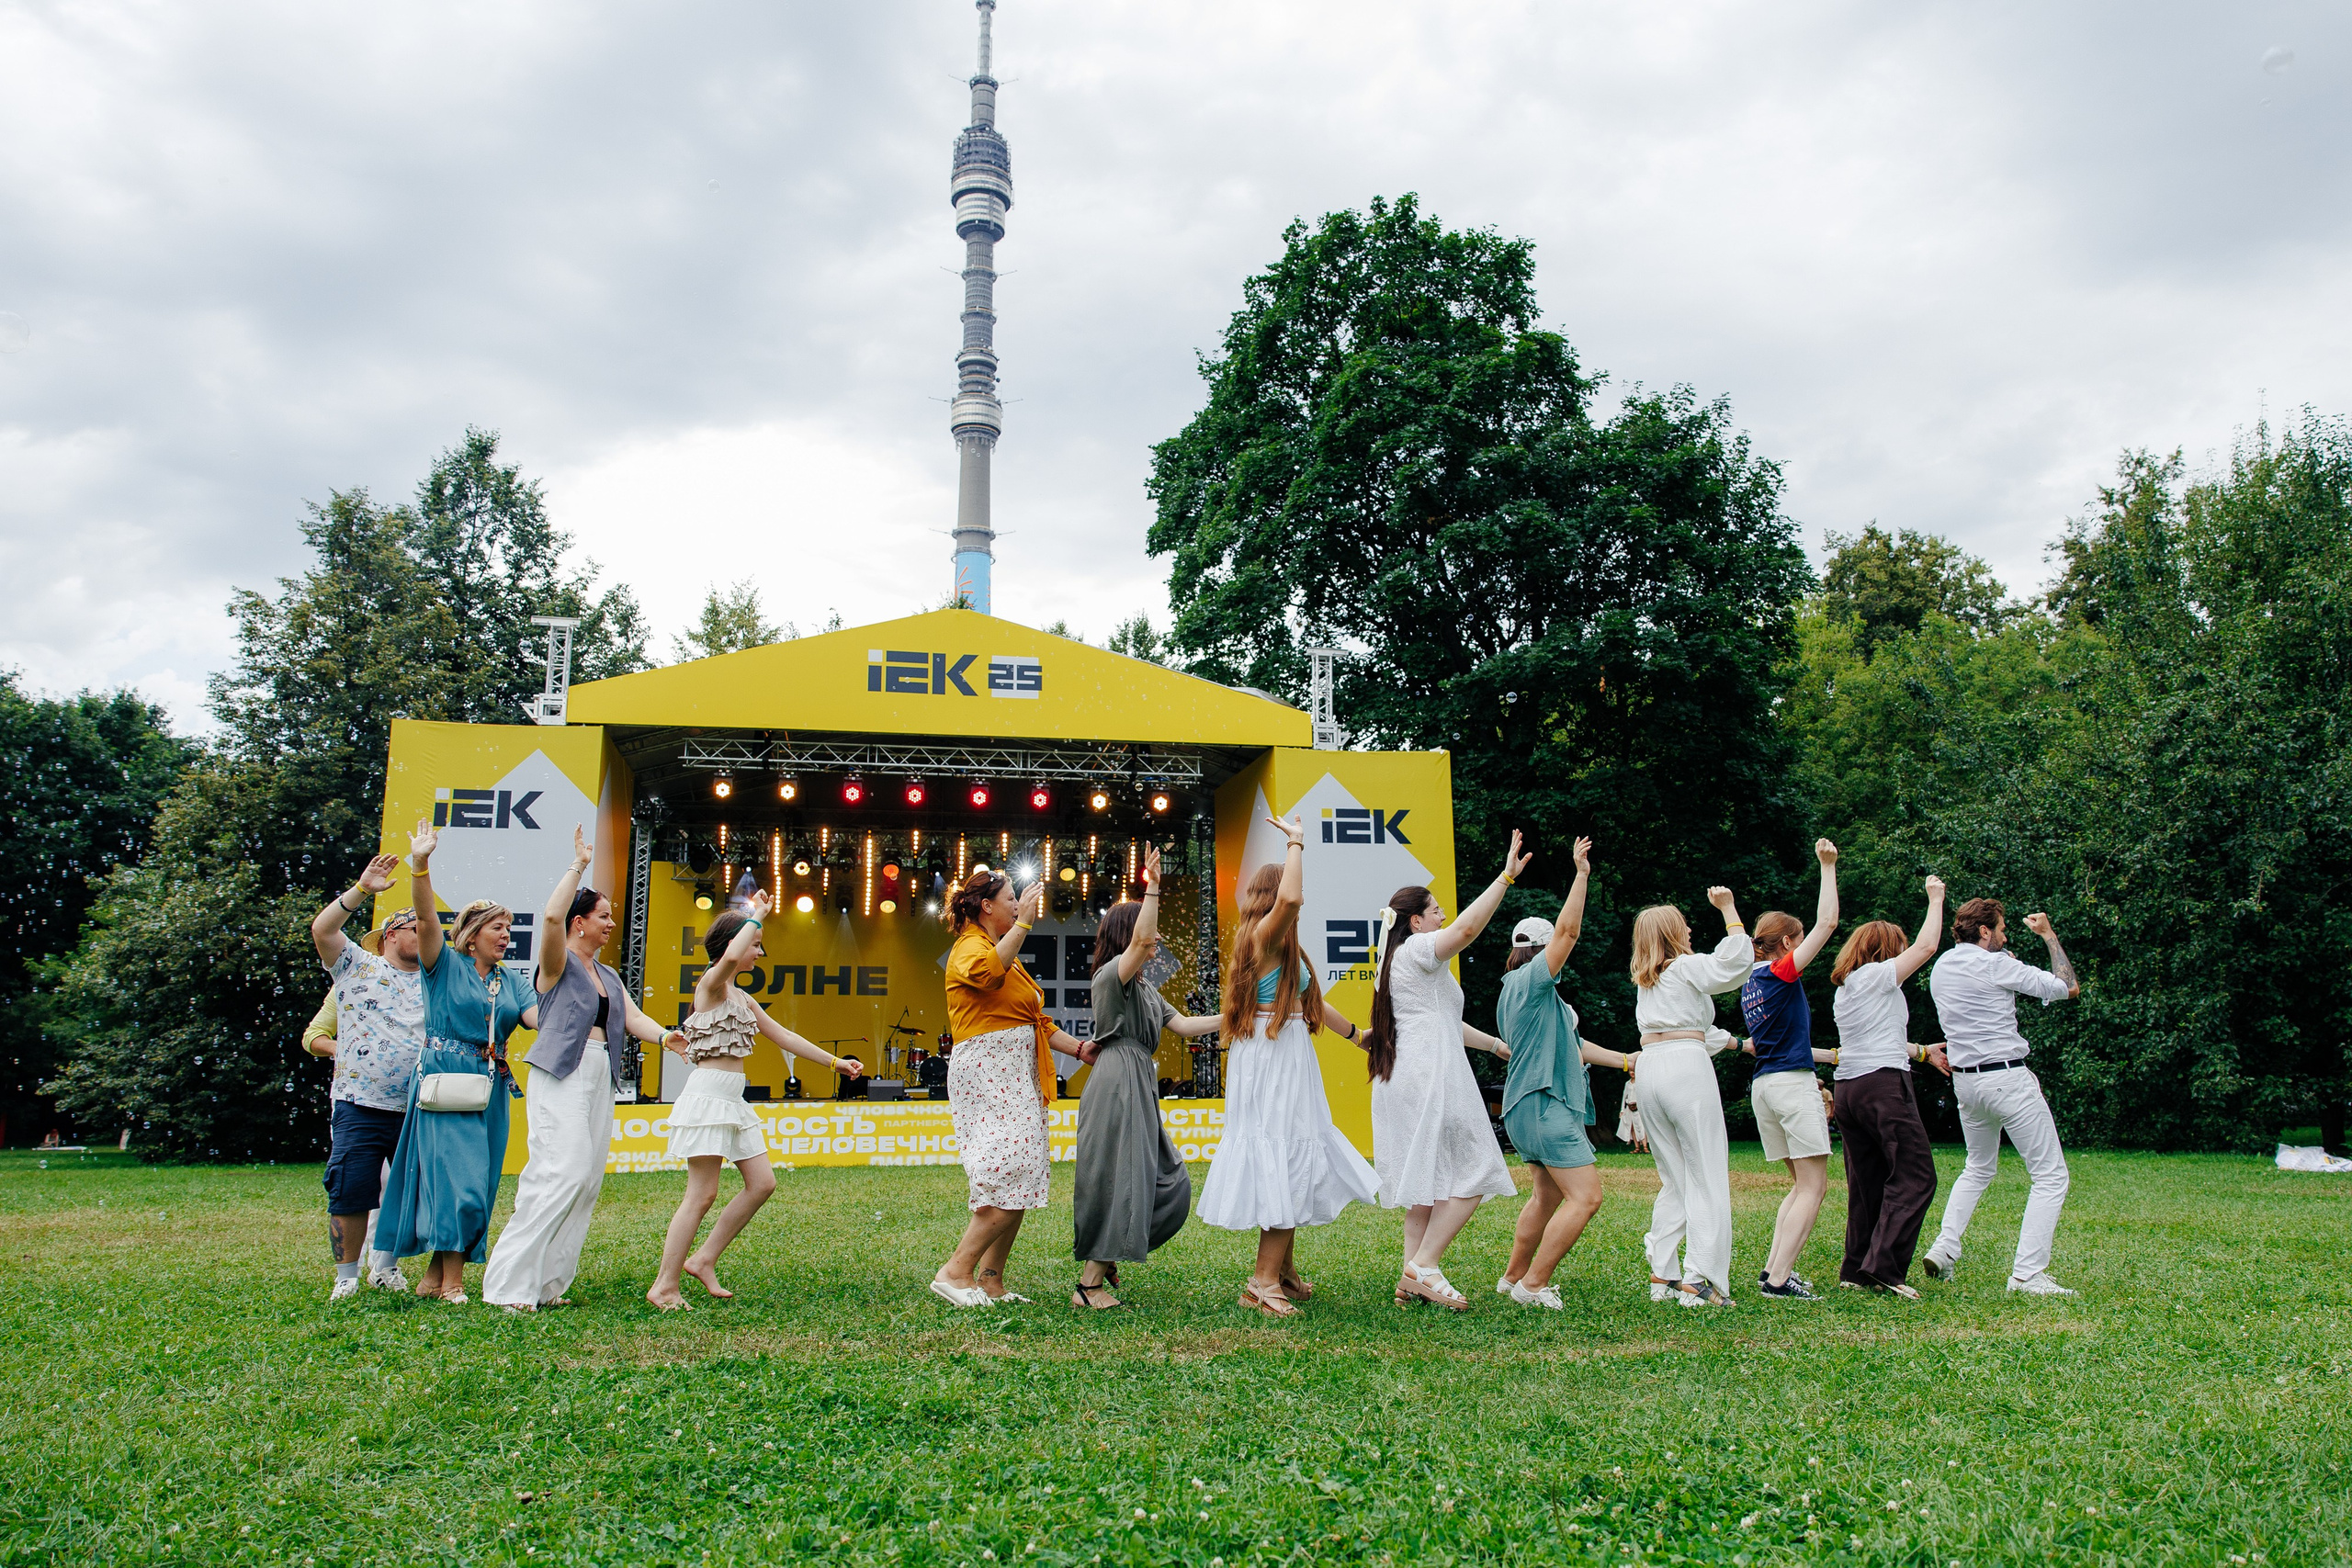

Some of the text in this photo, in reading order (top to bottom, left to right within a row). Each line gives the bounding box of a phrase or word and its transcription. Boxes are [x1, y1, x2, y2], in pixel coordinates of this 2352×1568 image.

[988, 663, 1043, 692] 25
[1326, 920, 1383, 964] 2
[1328, 970, 1356, 980] ЛЕТ
[769, 1134, 958, 1155] ЧЕЛОВЕЧНО
